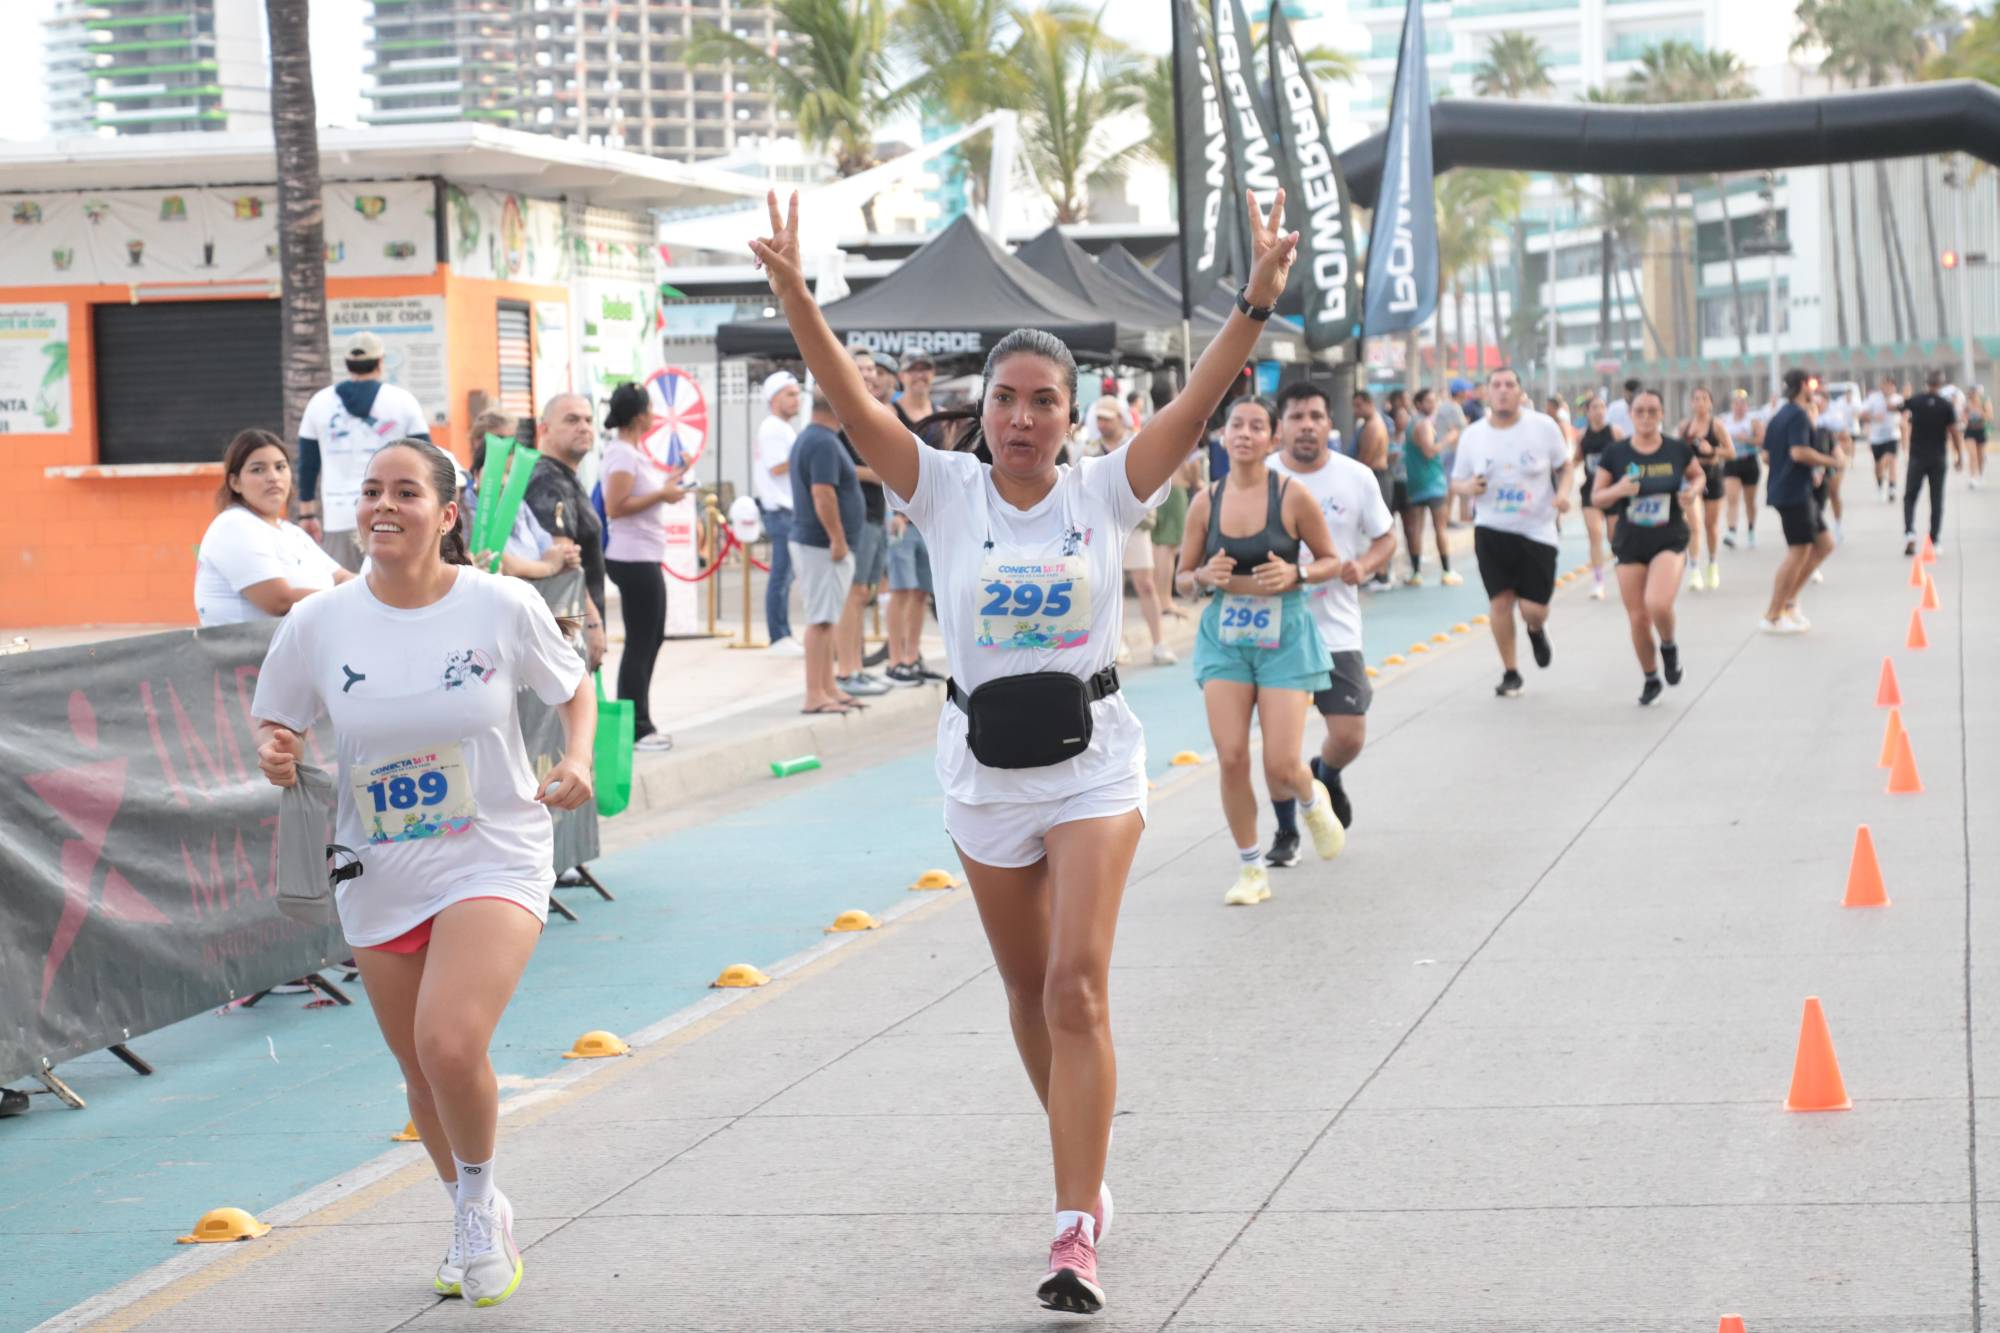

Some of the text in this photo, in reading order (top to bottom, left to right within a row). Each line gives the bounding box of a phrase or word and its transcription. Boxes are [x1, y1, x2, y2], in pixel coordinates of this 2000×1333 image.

[847, 331, 982, 352] POWERADE
[998, 564, 1042, 574] CONECTA
[980, 582, 1072, 617] 295
[1222, 607, 1271, 629] 296
[367, 771, 448, 813] 189
